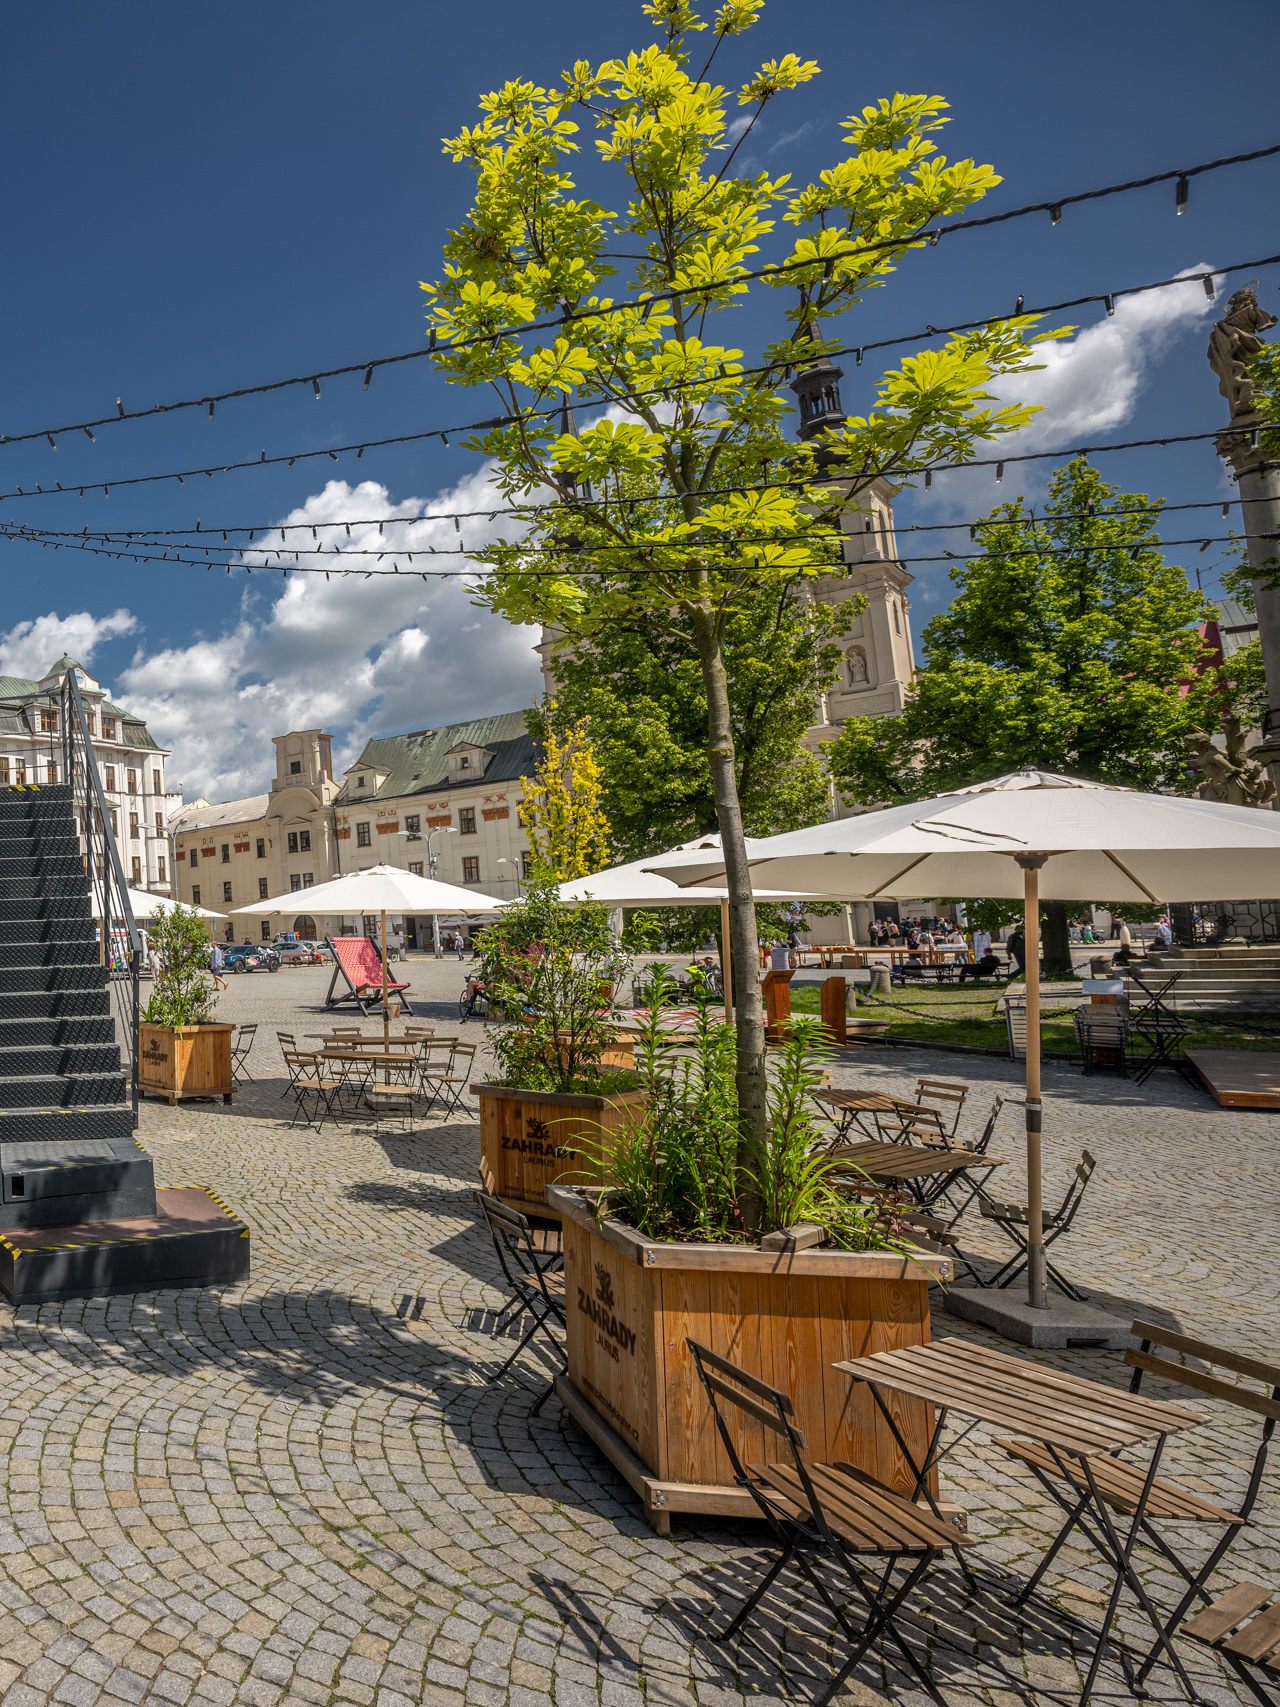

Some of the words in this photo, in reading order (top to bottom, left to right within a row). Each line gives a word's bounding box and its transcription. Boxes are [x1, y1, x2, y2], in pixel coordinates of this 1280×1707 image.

[523, 1155, 555, 1168] LAURUS
[577, 1286, 637, 1357] ZAHRADY
[594, 1328, 621, 1364] LAURUS
